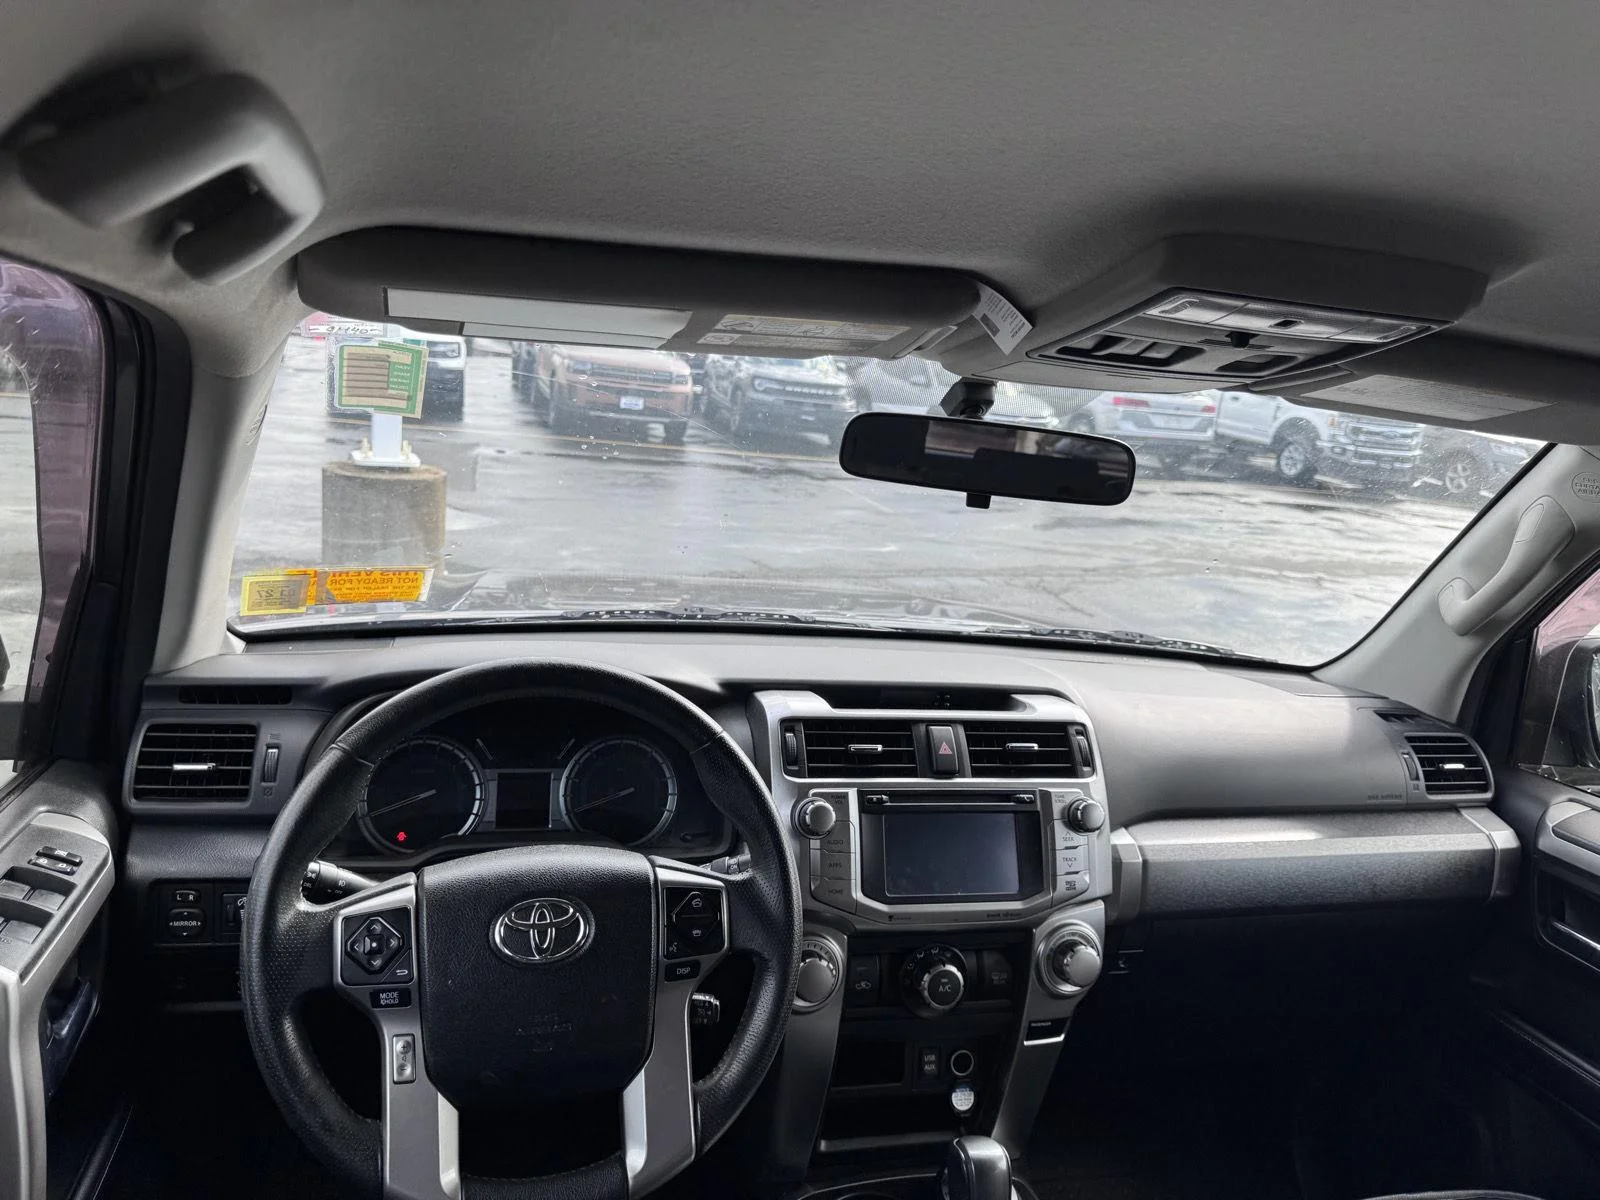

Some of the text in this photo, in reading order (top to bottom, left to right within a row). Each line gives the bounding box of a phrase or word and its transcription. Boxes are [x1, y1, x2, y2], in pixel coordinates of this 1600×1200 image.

[676, 967, 691, 975] DISP
[938, 984, 951, 992] A/C
[380, 991, 399, 999] MODE
